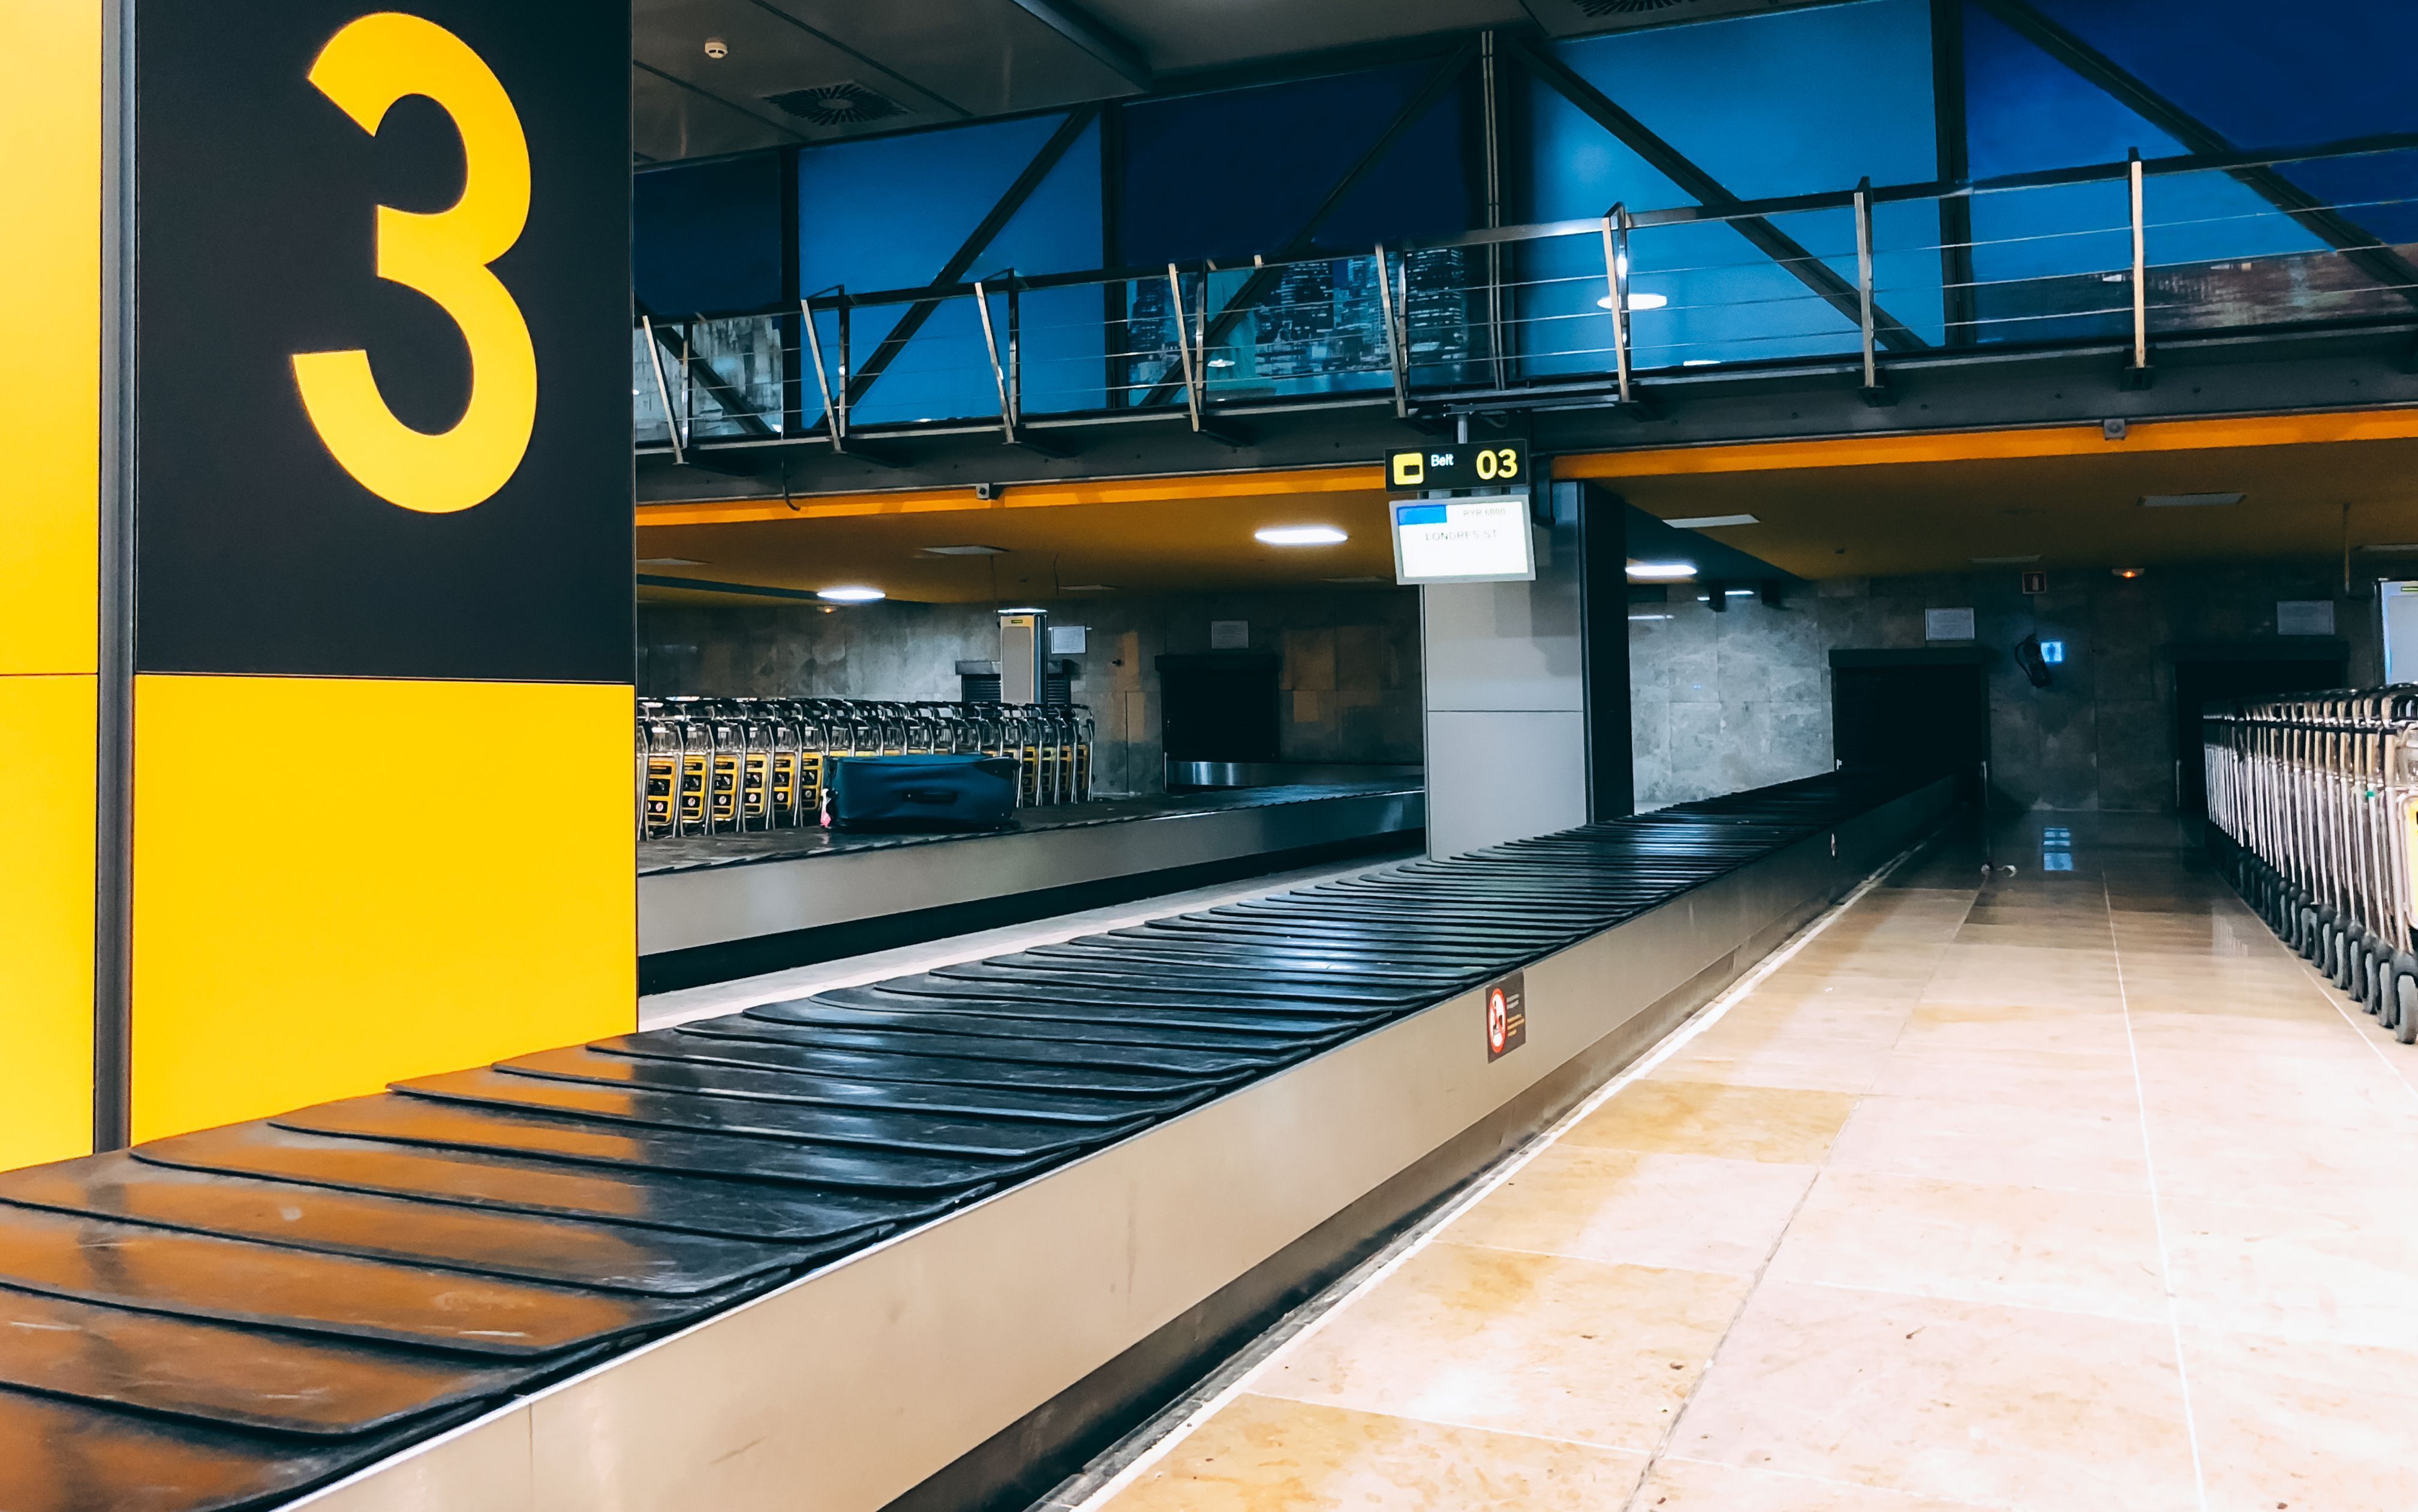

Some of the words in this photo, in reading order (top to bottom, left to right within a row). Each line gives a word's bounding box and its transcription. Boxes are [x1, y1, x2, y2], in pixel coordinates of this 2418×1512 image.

[292, 11, 537, 513] 3
[1431, 453, 1454, 467] Belt
[1476, 448, 1518, 480] 03
[1425, 530, 1479, 541] LONDRES
[1484, 529, 1497, 538] ST
